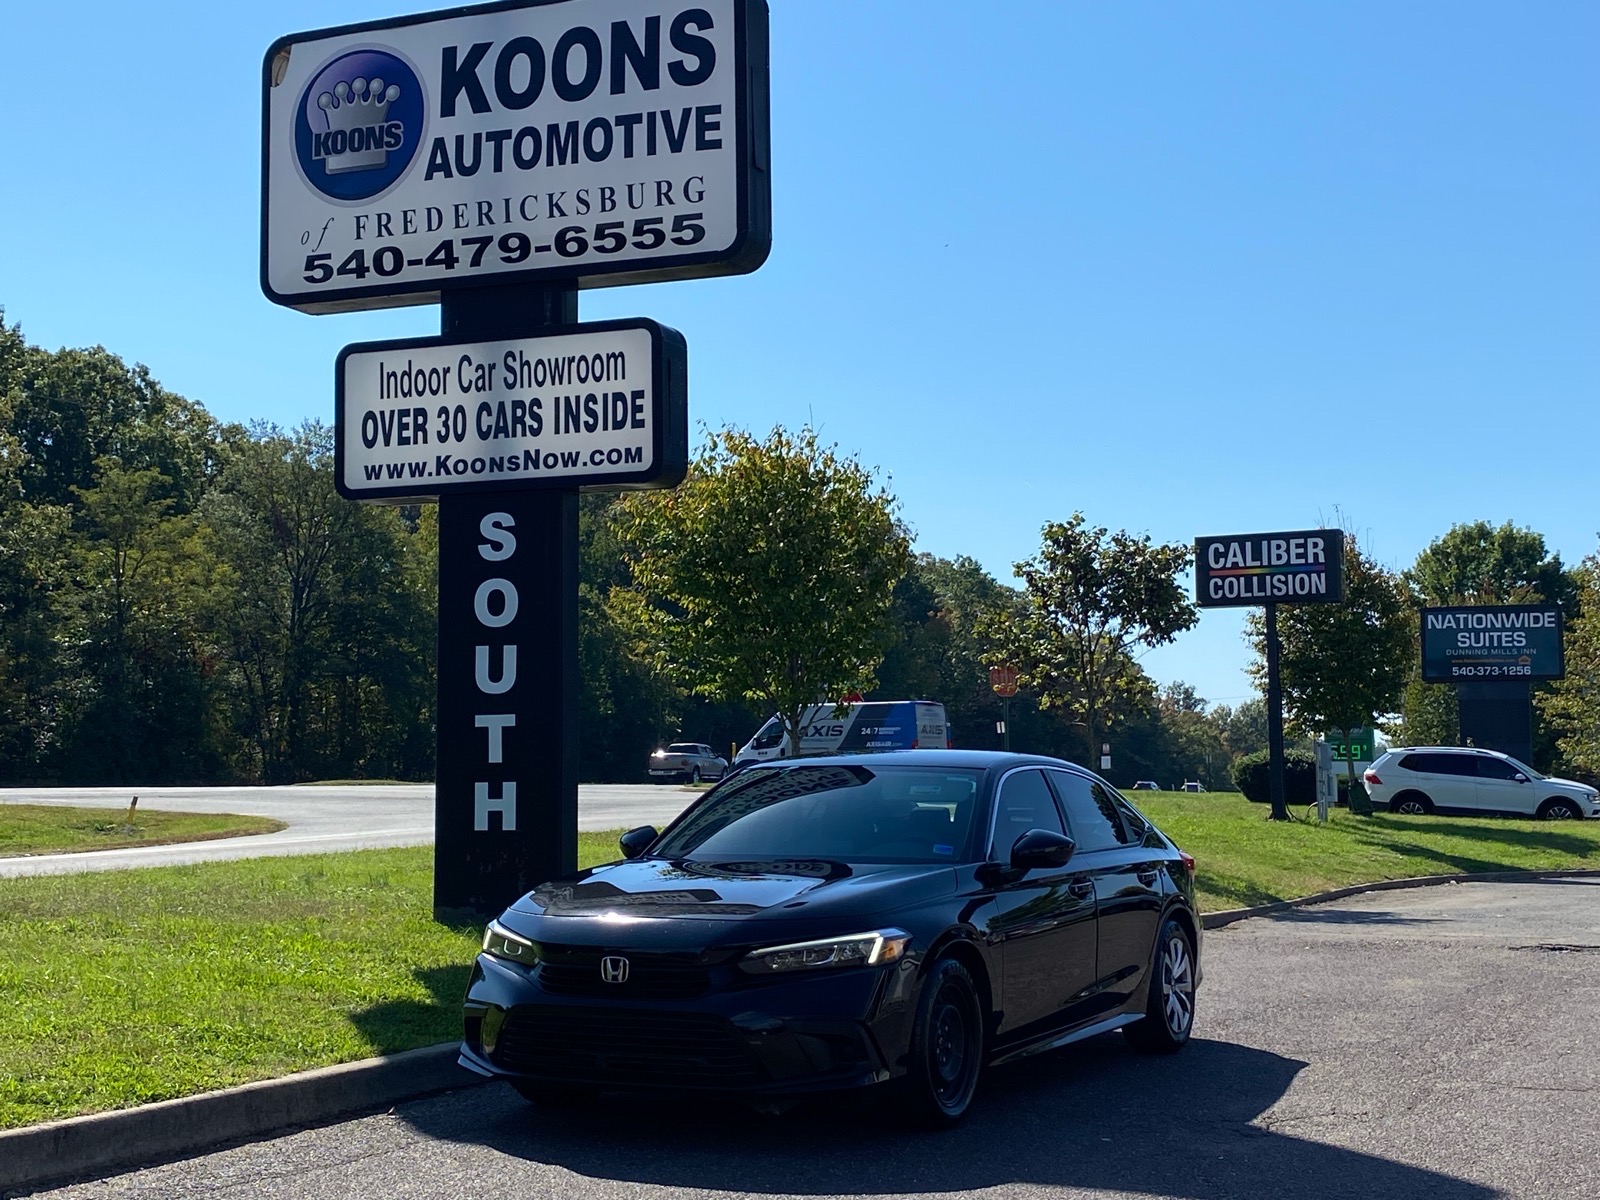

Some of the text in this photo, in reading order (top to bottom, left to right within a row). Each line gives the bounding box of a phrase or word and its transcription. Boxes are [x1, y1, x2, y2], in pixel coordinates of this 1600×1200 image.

[440, 8, 716, 118] KOONS
[313, 120, 404, 160] KOONS
[424, 104, 722, 181] AUTOMOTIVE
[300, 175, 706, 252] of FREDERICKSBURG
[302, 212, 706, 285] 540-479-6555
[380, 350, 626, 400] Indoor Car Showroom
[362, 389, 645, 449] OVER 30 CARS INSIDE
[1208, 537, 1325, 569] CALIBER
[1209, 572, 1326, 599] COLLISION
[1427, 612, 1556, 629] NATIONWIDE
[1457, 632, 1526, 647] SUITES
[474, 512, 519, 831] SOUTH
[1452, 666, 1531, 676] 540-373-1256
